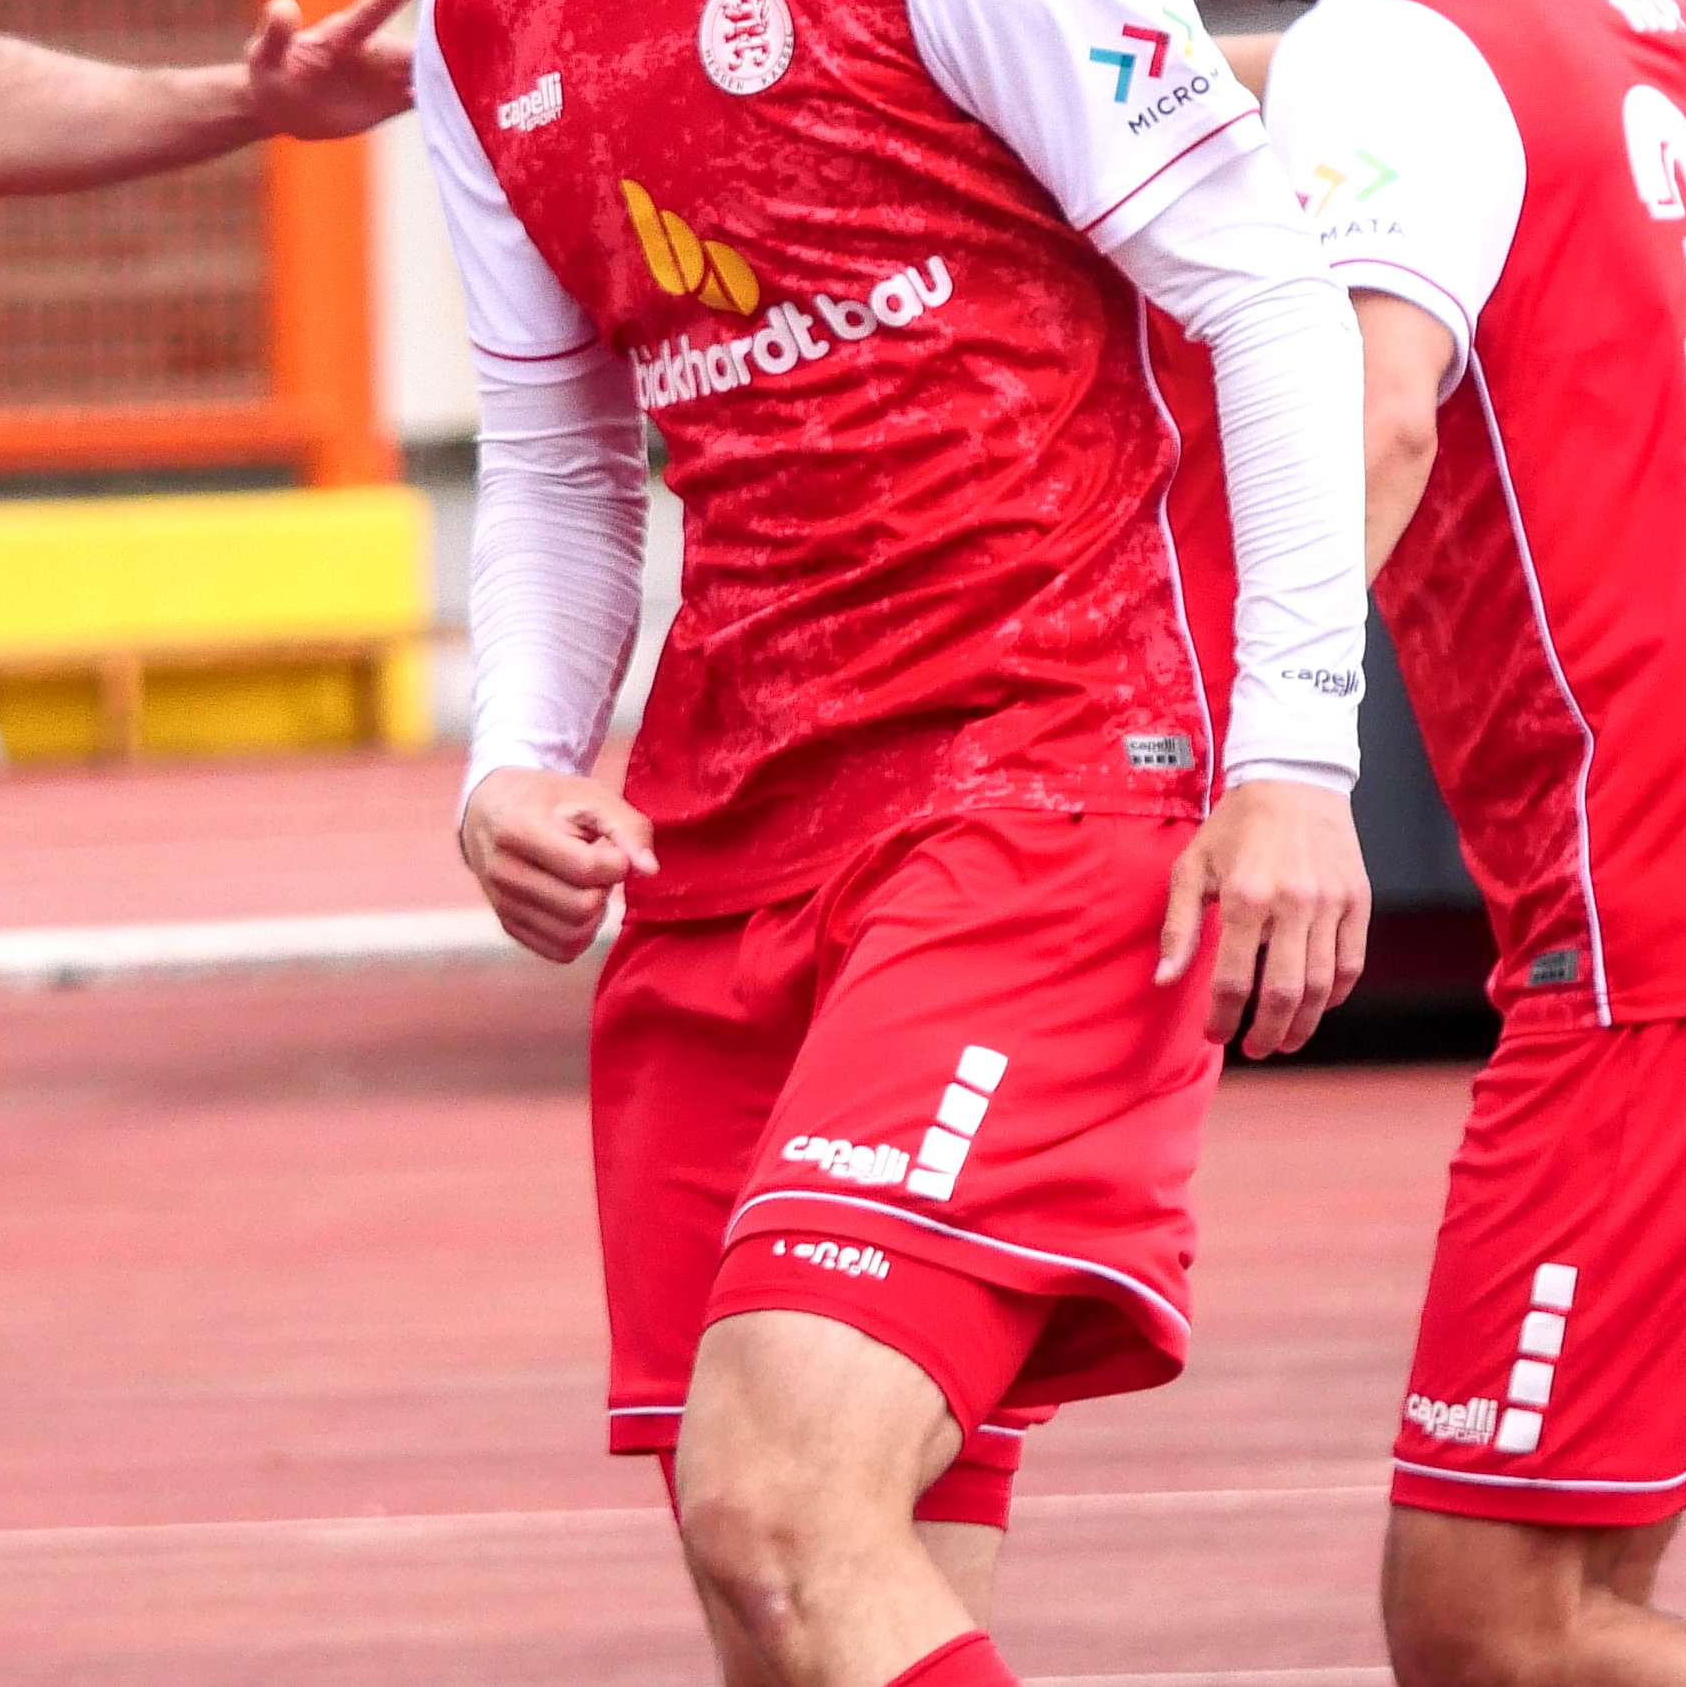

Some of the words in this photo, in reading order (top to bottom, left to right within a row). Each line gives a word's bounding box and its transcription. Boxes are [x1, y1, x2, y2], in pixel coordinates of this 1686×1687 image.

[496, 71, 563, 131] capelli
[814, 255, 954, 340] bau
[1281, 669, 1359, 696] capelli
[782, 1136, 910, 1183] capelli
[1407, 1394, 1498, 1435] capelli
